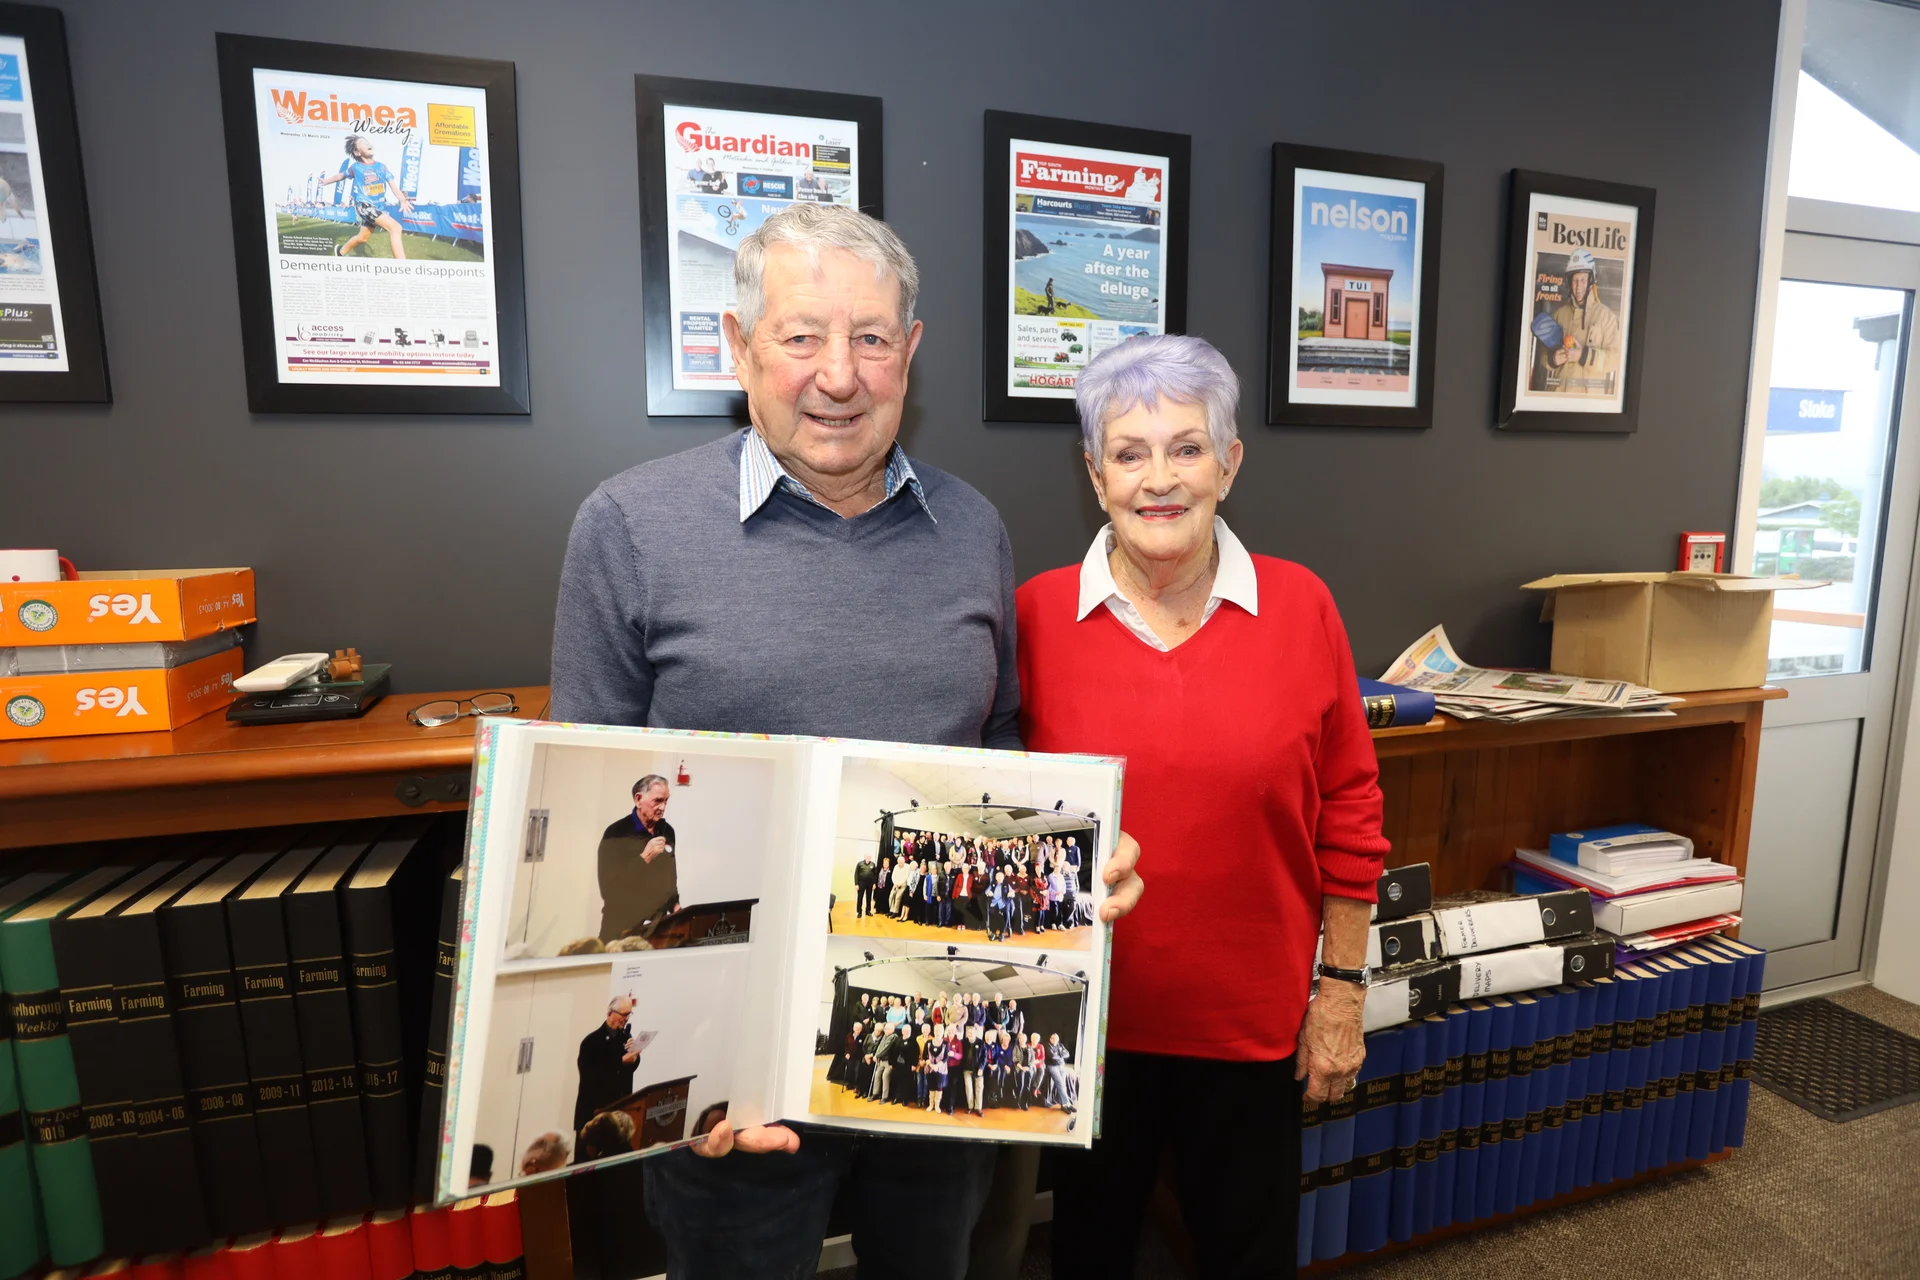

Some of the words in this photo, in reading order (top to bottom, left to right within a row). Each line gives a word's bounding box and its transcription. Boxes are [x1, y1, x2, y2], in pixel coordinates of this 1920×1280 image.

[271, 88, 417, 129] Waimea
[349, 118, 412, 147] Weekly
[434, 129, 471, 137] Cremations
[435, 122, 469, 130] Affordable
[675, 122, 810, 158] Guardian
[1021, 160, 1119, 192] Farming
[763, 182, 786, 190] RESCUE
[1036, 198, 1072, 208] Harcourts
[1311, 199, 1408, 234] nelson
[1380, 234, 1408, 242] magazine
[1103, 244, 1114, 256] A
[1118, 247, 1150, 261] year
[280, 259, 342, 272] Dementia
[346, 262, 370, 274] unit
[374, 264, 412, 276] pause
[415, 265, 486, 278] disappoints
[1084, 261, 1122, 276] after
[1125, 264, 1150, 278] the
[1349, 281, 1368, 290] TUI
[1536, 274, 1564, 286] Firing
[1100, 280, 1149, 299] deluge
[1536, 290, 1562, 302] fronts
[312, 324, 344, 332] access
[1017, 324, 1038, 334] Sales,
[1040, 326, 1058, 334] parts
[1032, 336, 1057, 344] service
[378, 350, 405, 358] mobility
[1798, 398, 1836, 419] Stoke
[214, 602, 220, 611] 80
[232, 592, 244, 608] Yes
[89, 594, 162, 624] Yes
[220, 672, 233, 686] Yes
[76, 686, 148, 716] Yes
[1380, 699, 1394, 726] Nelson
[1458, 920, 1467, 949] FORMER
[244, 974, 284, 990] Farming
[300, 968, 340, 983] Farming
[1472, 962, 1482, 998] DELIVERY
[1484, 969, 1492, 992] MAPS
[184, 982, 226, 998] Farming
[9, 998, 64, 1018] arlboroug
[69, 996, 113, 1014] Farming
[121, 994, 165, 1011] Farming
[16, 1020, 59, 1034] Weekly
[1366, 1080, 1392, 1096] Nelson
